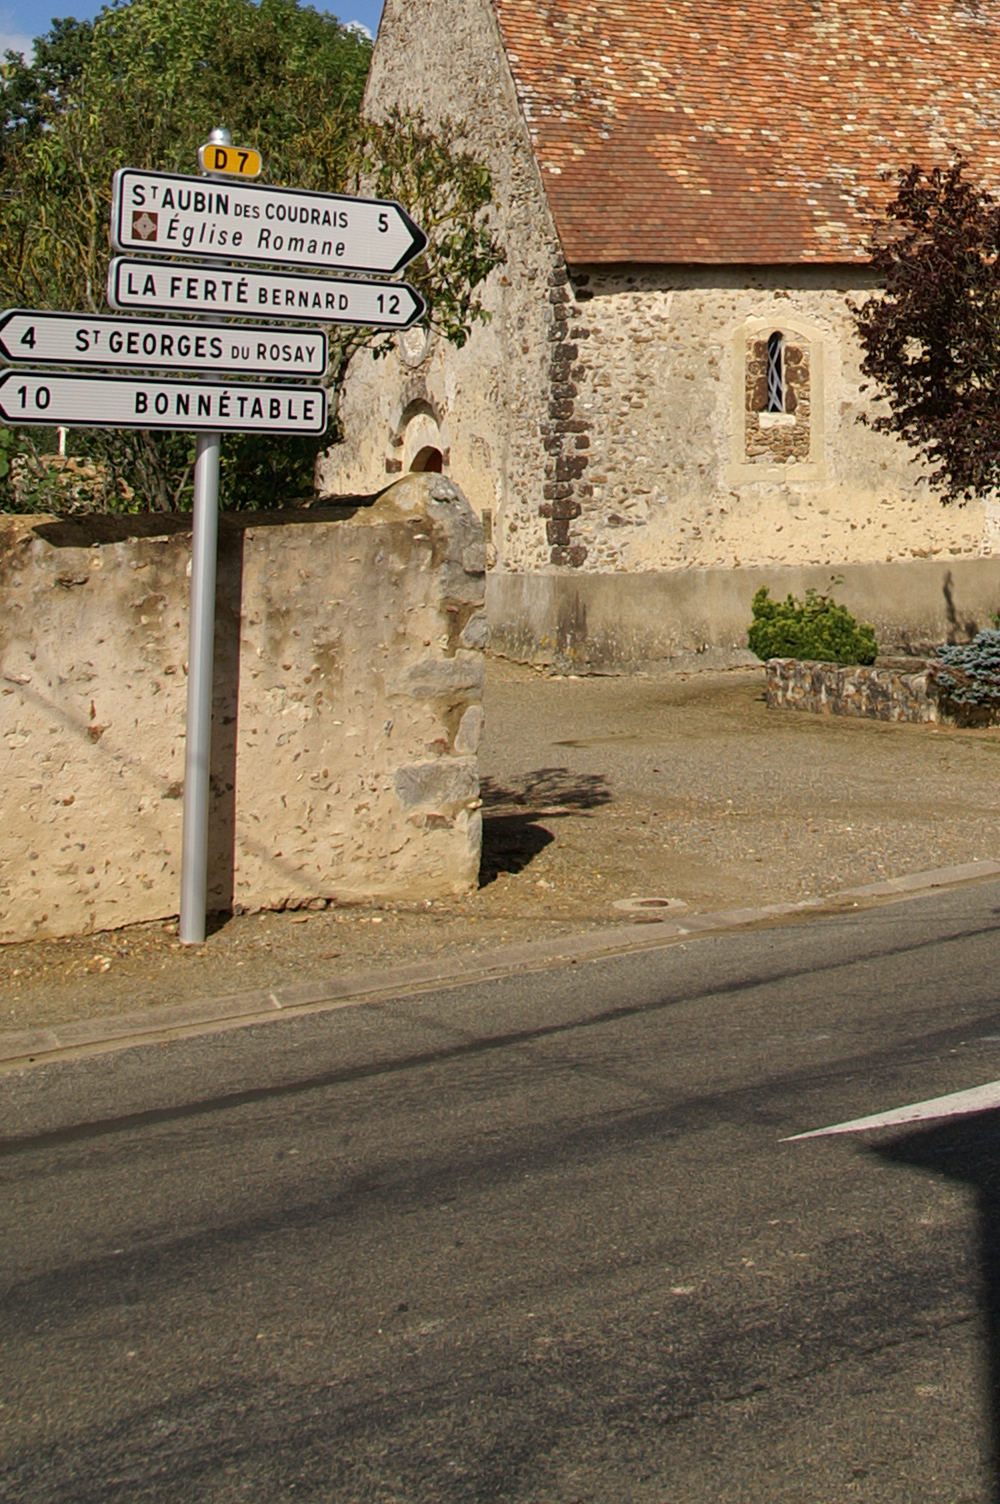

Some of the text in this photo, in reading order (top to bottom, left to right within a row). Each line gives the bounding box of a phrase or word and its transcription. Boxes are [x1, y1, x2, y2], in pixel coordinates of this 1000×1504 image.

[214, 149, 250, 173] D 7
[161, 187, 229, 216] AUBIN
[234, 202, 260, 219] DES
[264, 203, 349, 229] COUDRAIS
[377, 213, 389, 233] 5
[166, 214, 346, 257] Église Romane
[127, 273, 401, 315] LA FERTÉ BERNARD 12
[21, 327, 37, 349] 4
[108, 330, 223, 358] GEORGES
[231, 344, 250, 360] DU
[257, 344, 316, 363] ROSAY
[17, 385, 315, 421] 10 BONNÉTABLE
